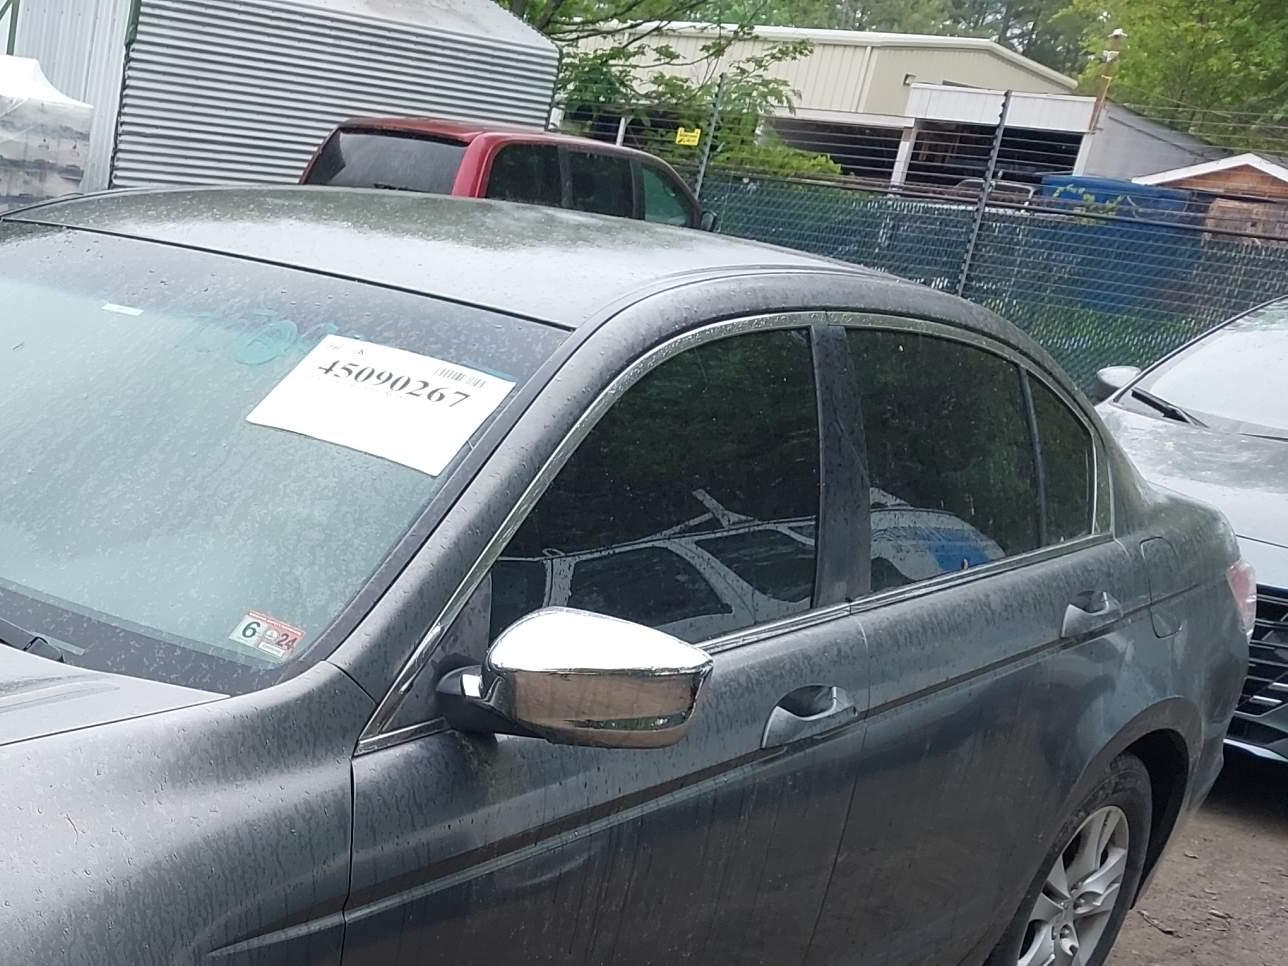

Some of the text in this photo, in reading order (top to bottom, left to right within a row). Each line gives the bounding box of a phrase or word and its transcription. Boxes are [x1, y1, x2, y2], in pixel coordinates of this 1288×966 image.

[318, 359, 471, 408] 45090267
[242, 621, 261, 638] 6
[277, 633, 298, 650] 24
